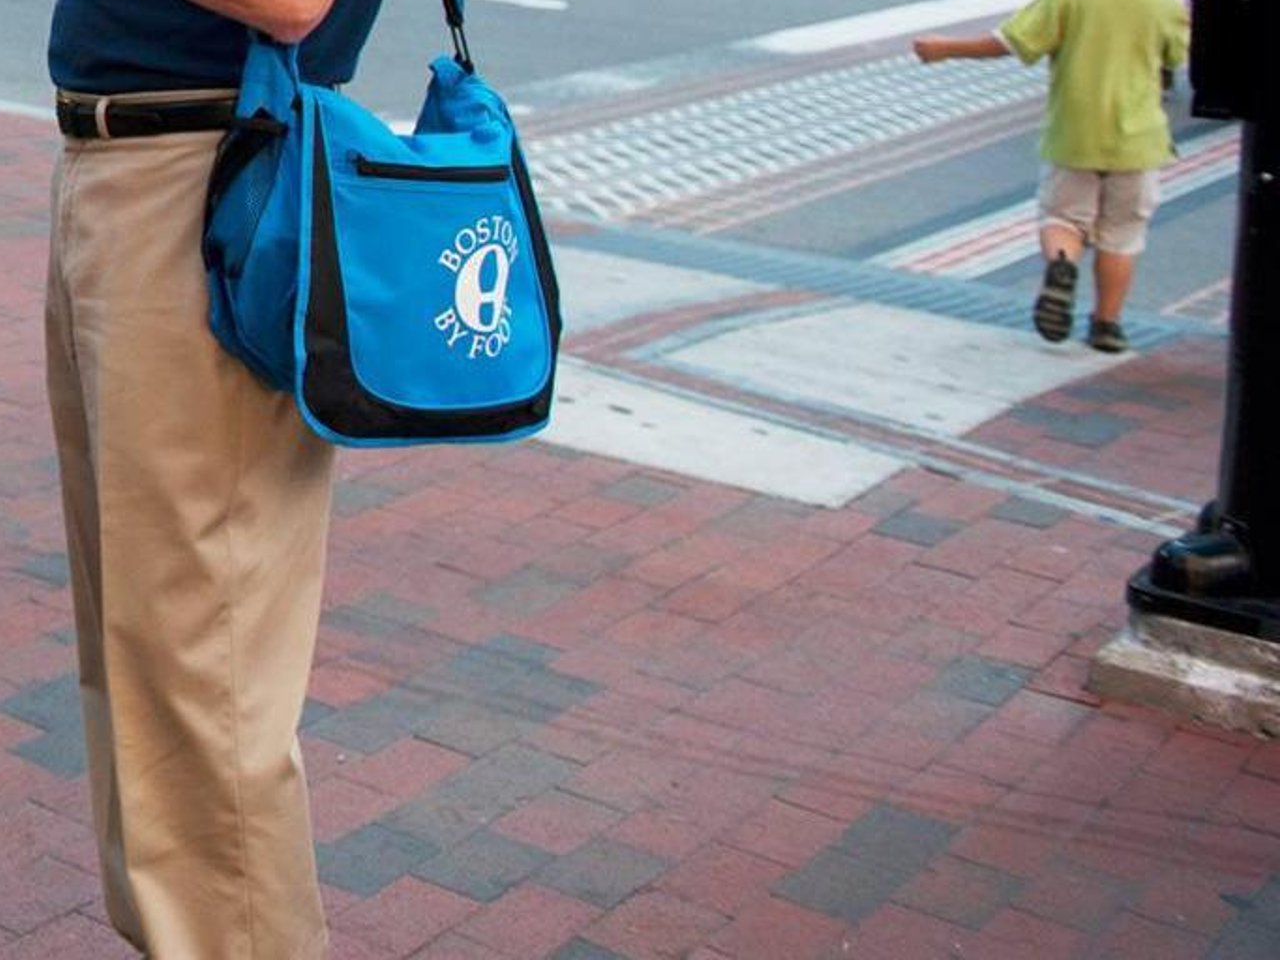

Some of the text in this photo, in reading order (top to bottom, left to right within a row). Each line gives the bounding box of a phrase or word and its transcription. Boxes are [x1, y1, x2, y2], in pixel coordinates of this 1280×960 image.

[438, 216, 519, 272] BOSTON
[434, 299, 512, 360] BY FOOT
